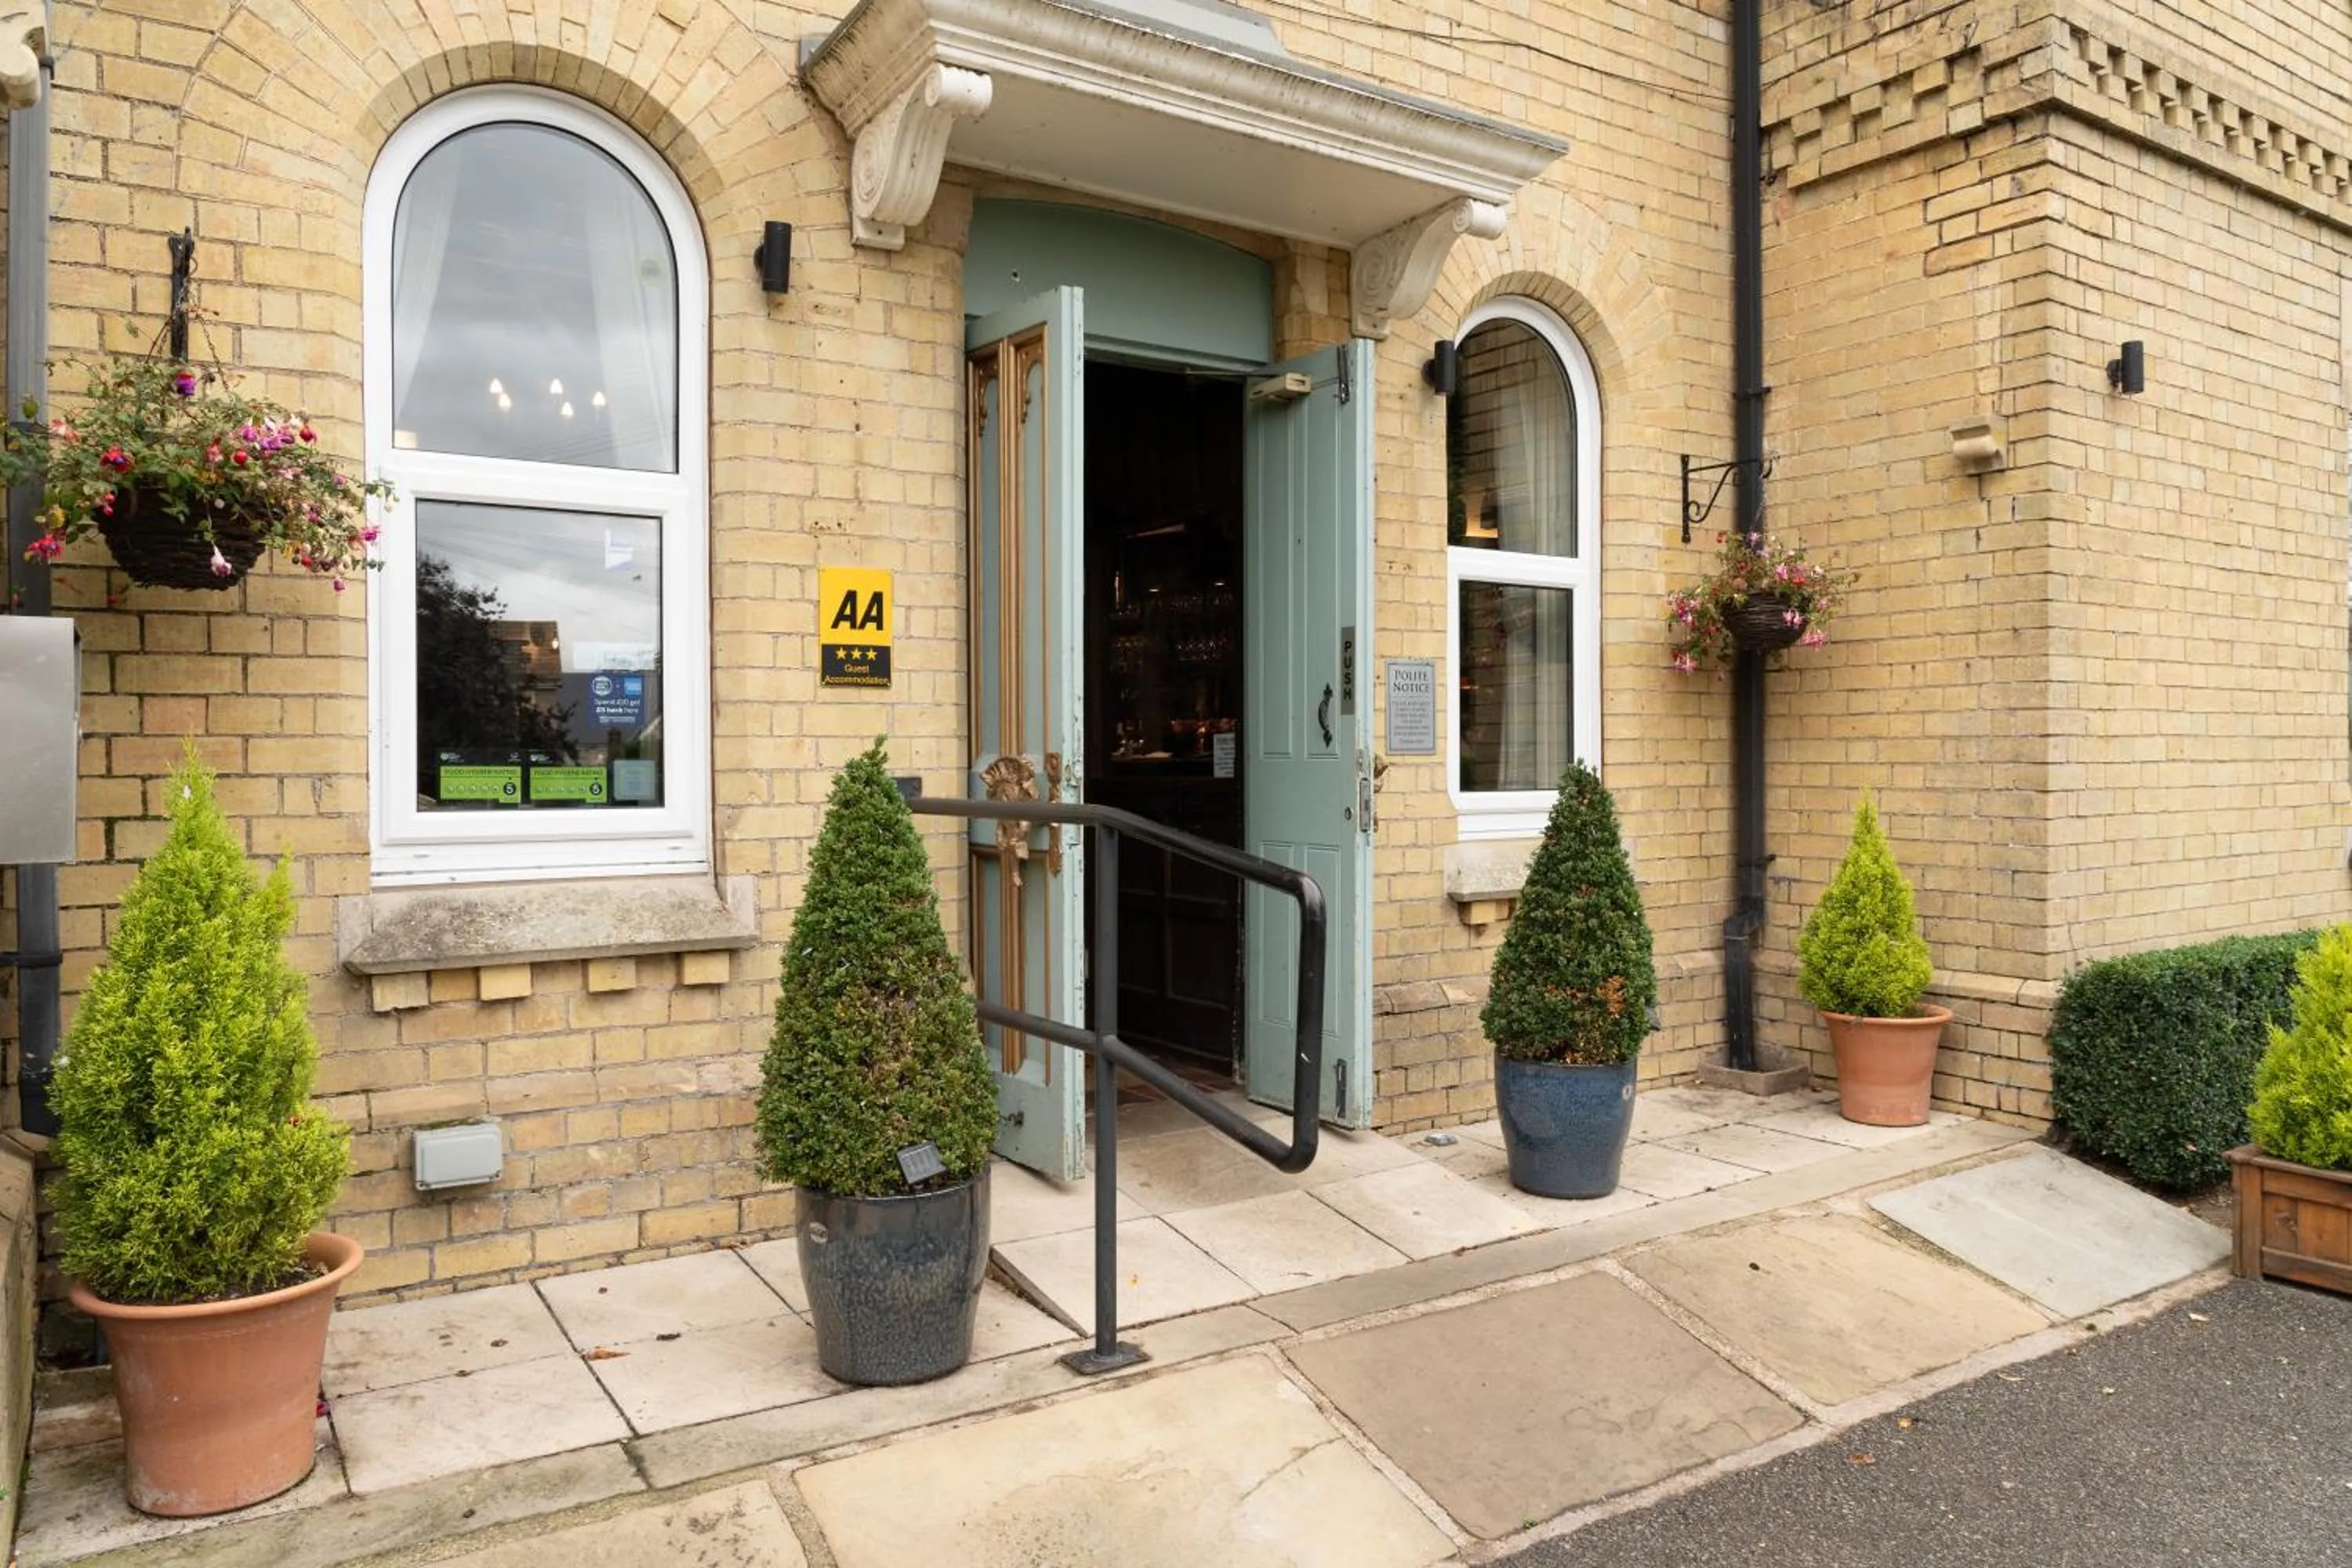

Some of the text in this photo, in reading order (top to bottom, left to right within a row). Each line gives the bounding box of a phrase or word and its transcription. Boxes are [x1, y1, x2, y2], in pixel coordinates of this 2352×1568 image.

[831, 590, 884, 630] AA
[844, 663, 870, 673] Guest
[1343, 641, 1352, 700] PUSH
[824, 675, 889, 685] Accommodation
[1395, 670, 1428, 681] POLITE
[1393, 682, 1429, 692] NOTICE
[506, 783, 514, 794] 5
